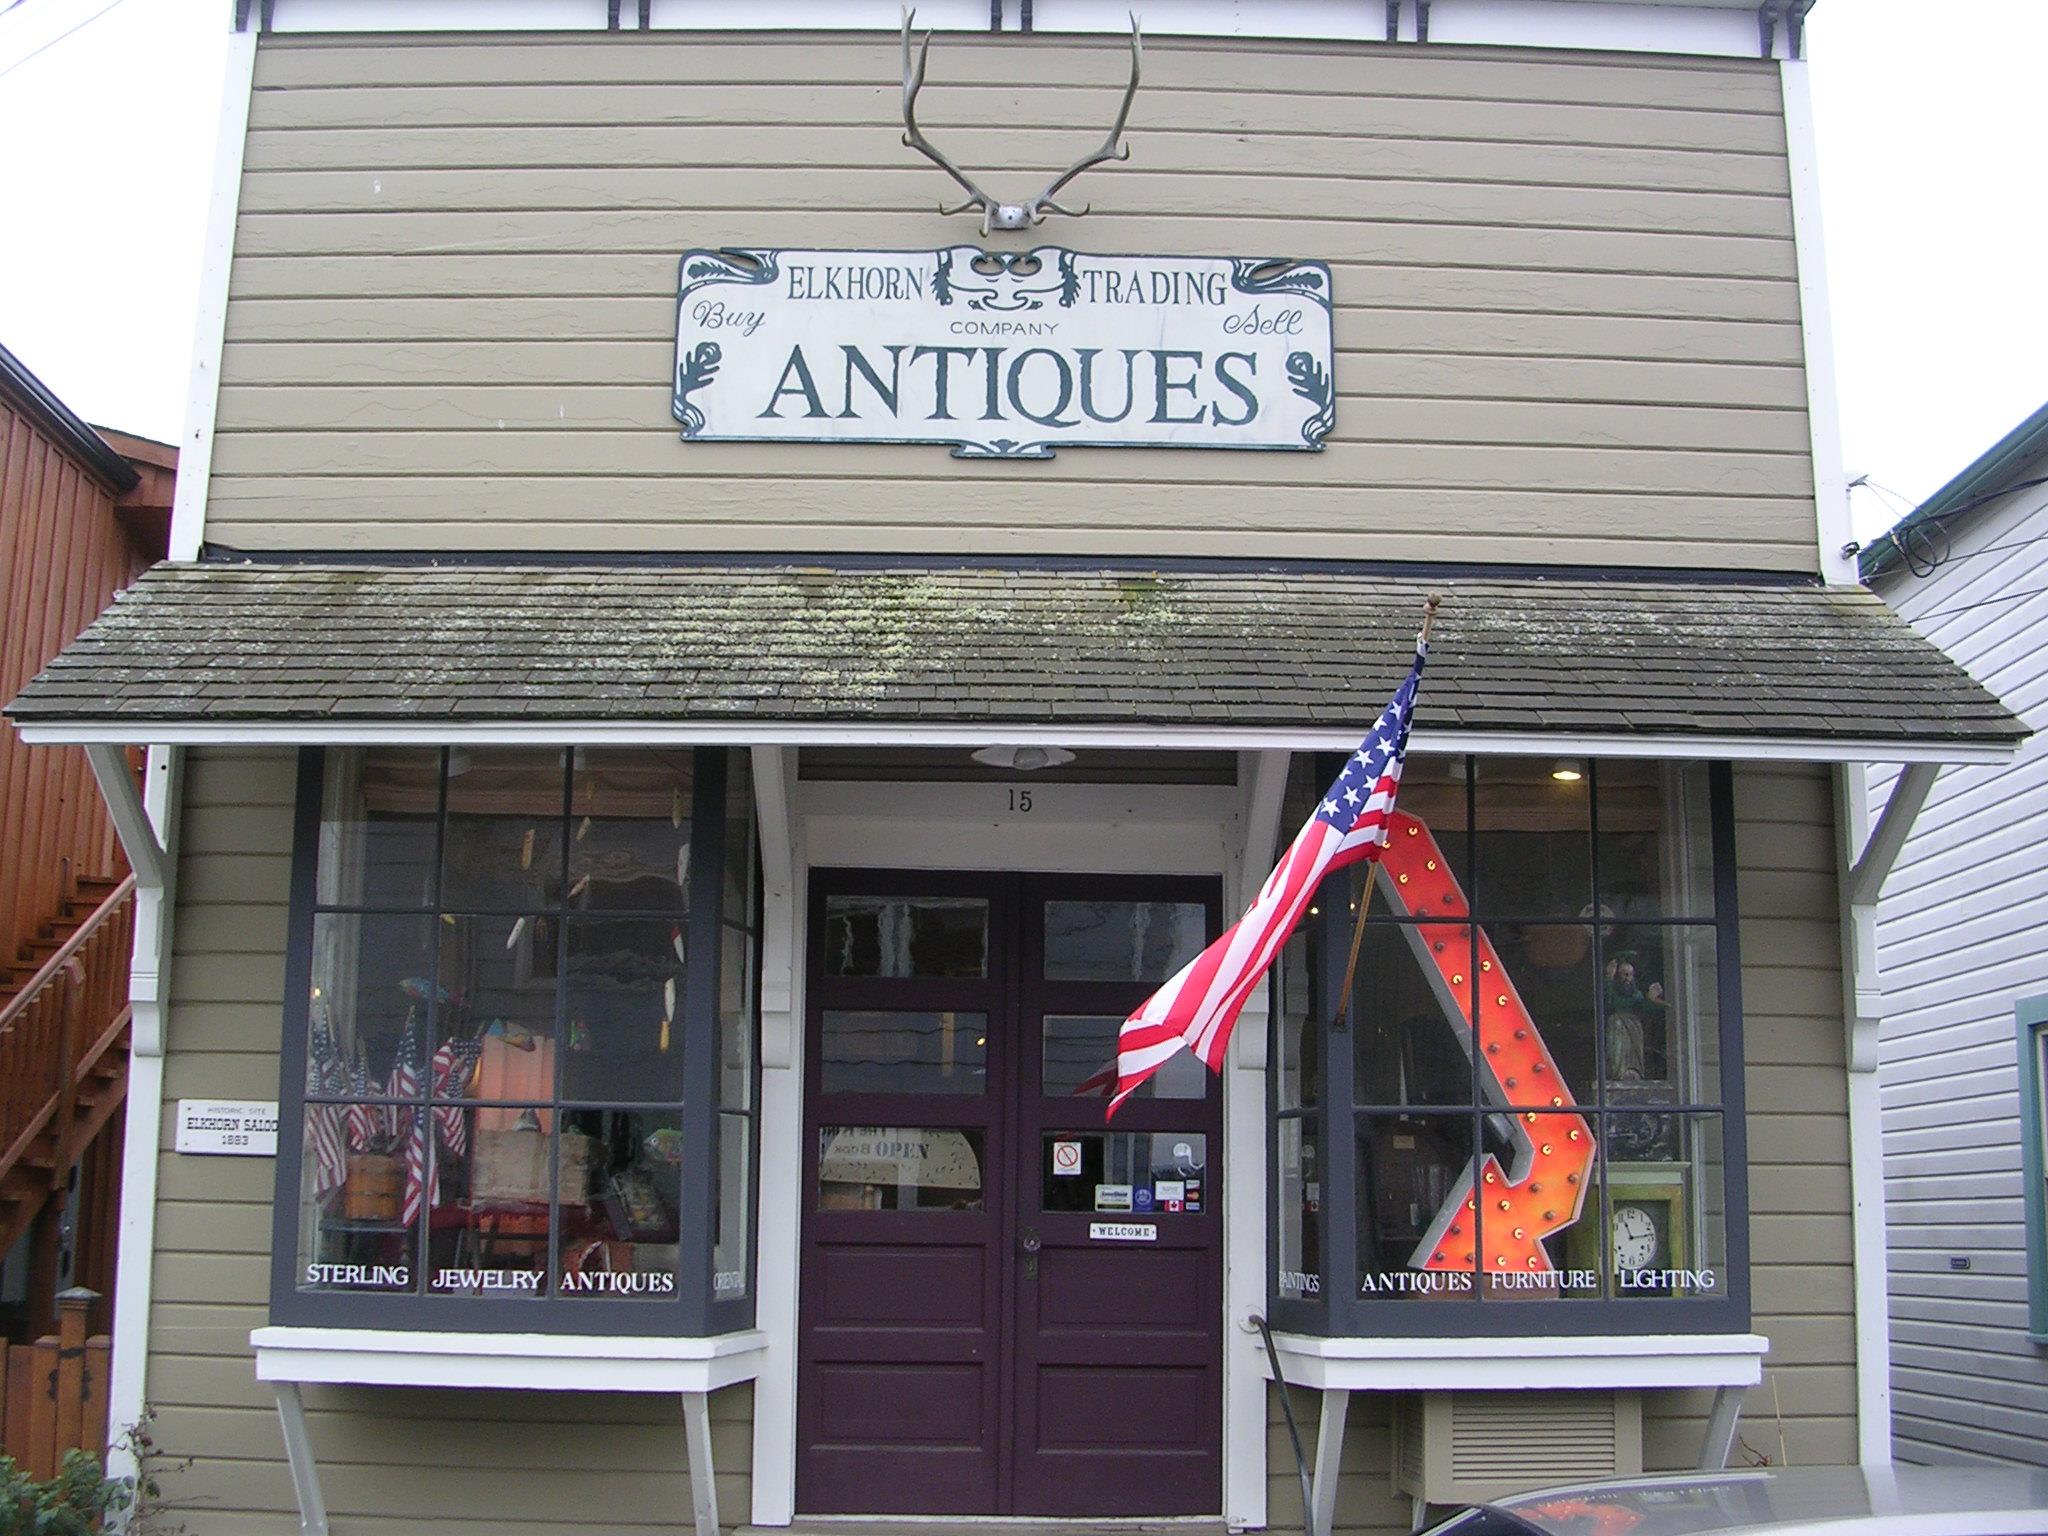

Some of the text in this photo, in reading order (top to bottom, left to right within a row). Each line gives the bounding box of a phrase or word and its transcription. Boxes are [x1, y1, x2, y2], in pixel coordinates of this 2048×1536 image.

[787, 266, 1228, 306] ELKHORN TRADING
[693, 300, 766, 337] Buy
[950, 320, 1060, 336] COMPANY
[1223, 303, 1304, 335] Sell
[755, 344, 1260, 429] ANTIQUES
[1009, 788, 1032, 813] 15
[207, 1107, 267, 1115] HISTORIC SITE
[187, 1117, 241, 1131] ELKHORN
[875, 1142, 930, 1160] OPEN
[1098, 1226, 1151, 1237] WELCOME
[307, 1264, 674, 1293] STERLING JEWELRY ANTIQUES
[1279, 1271, 1320, 1292] PAINTINGS
[1362, 1269, 1715, 1293] ANTIQUES FURNITURE LIGHTING
